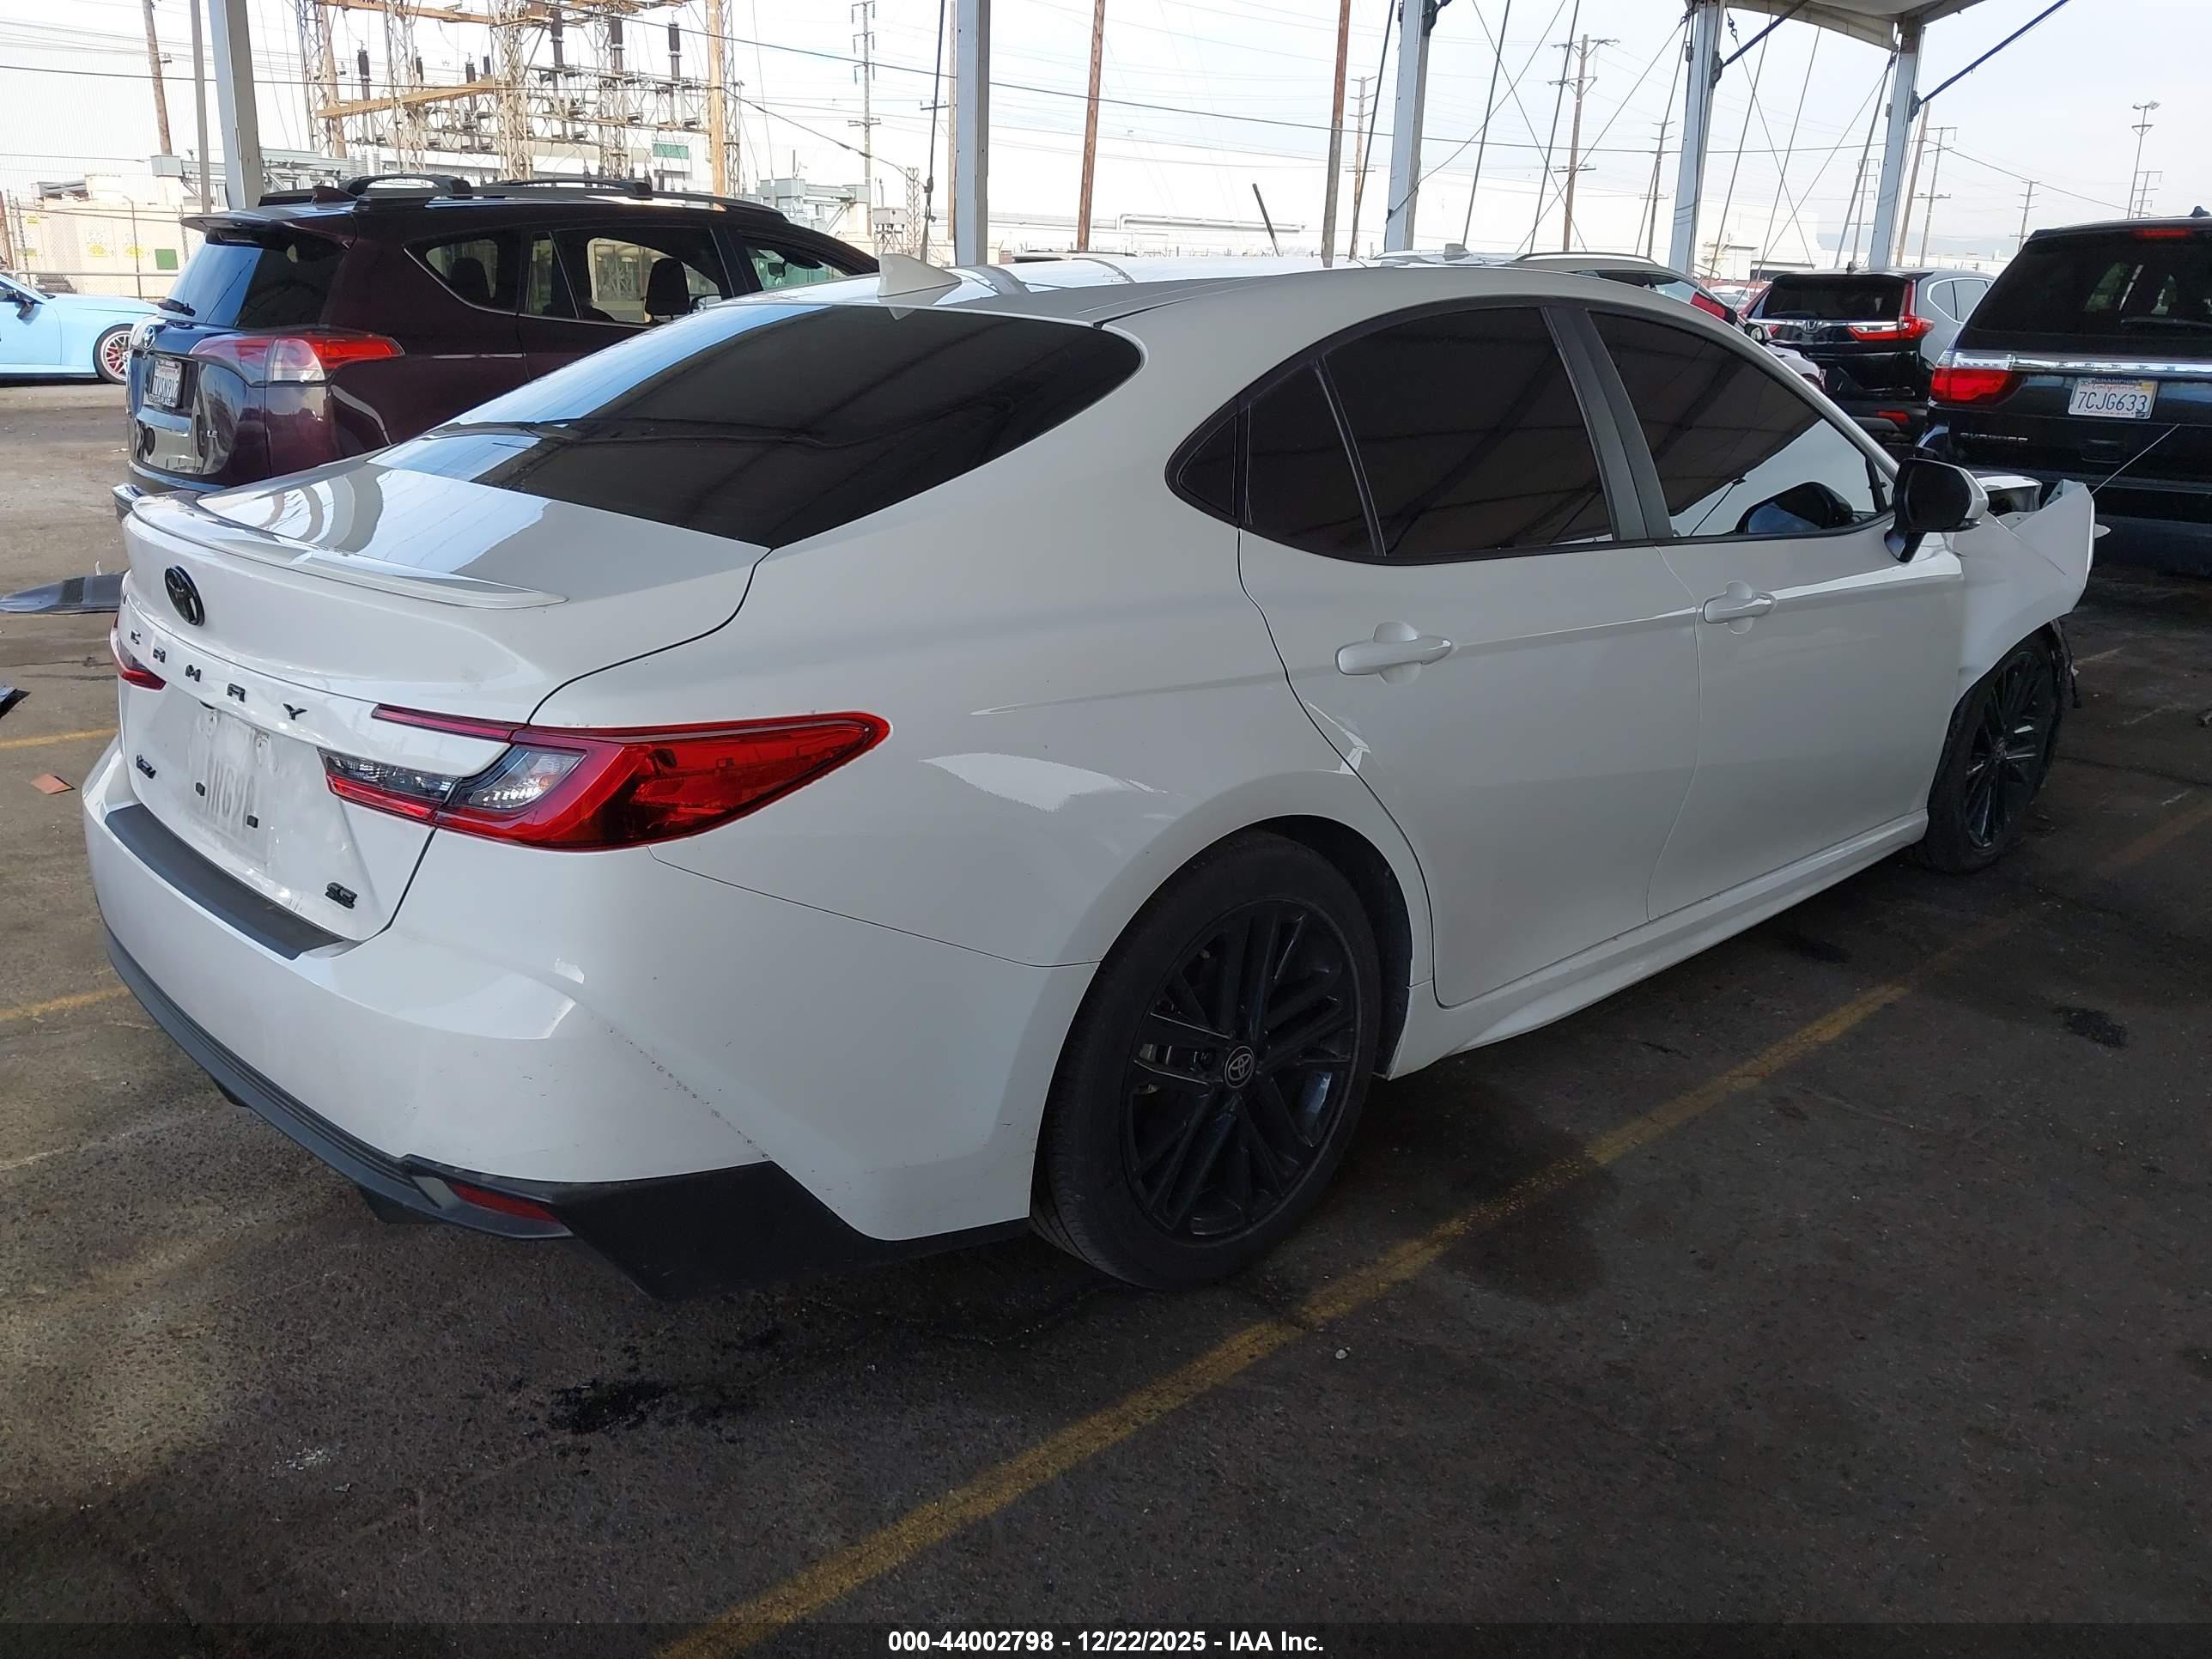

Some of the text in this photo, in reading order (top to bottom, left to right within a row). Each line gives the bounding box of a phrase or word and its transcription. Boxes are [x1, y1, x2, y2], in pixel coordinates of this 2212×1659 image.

[2077, 392, 2148, 412] 7CJG633
[130, 629, 308, 721] CAMRY
[325, 881, 358, 910] SE
